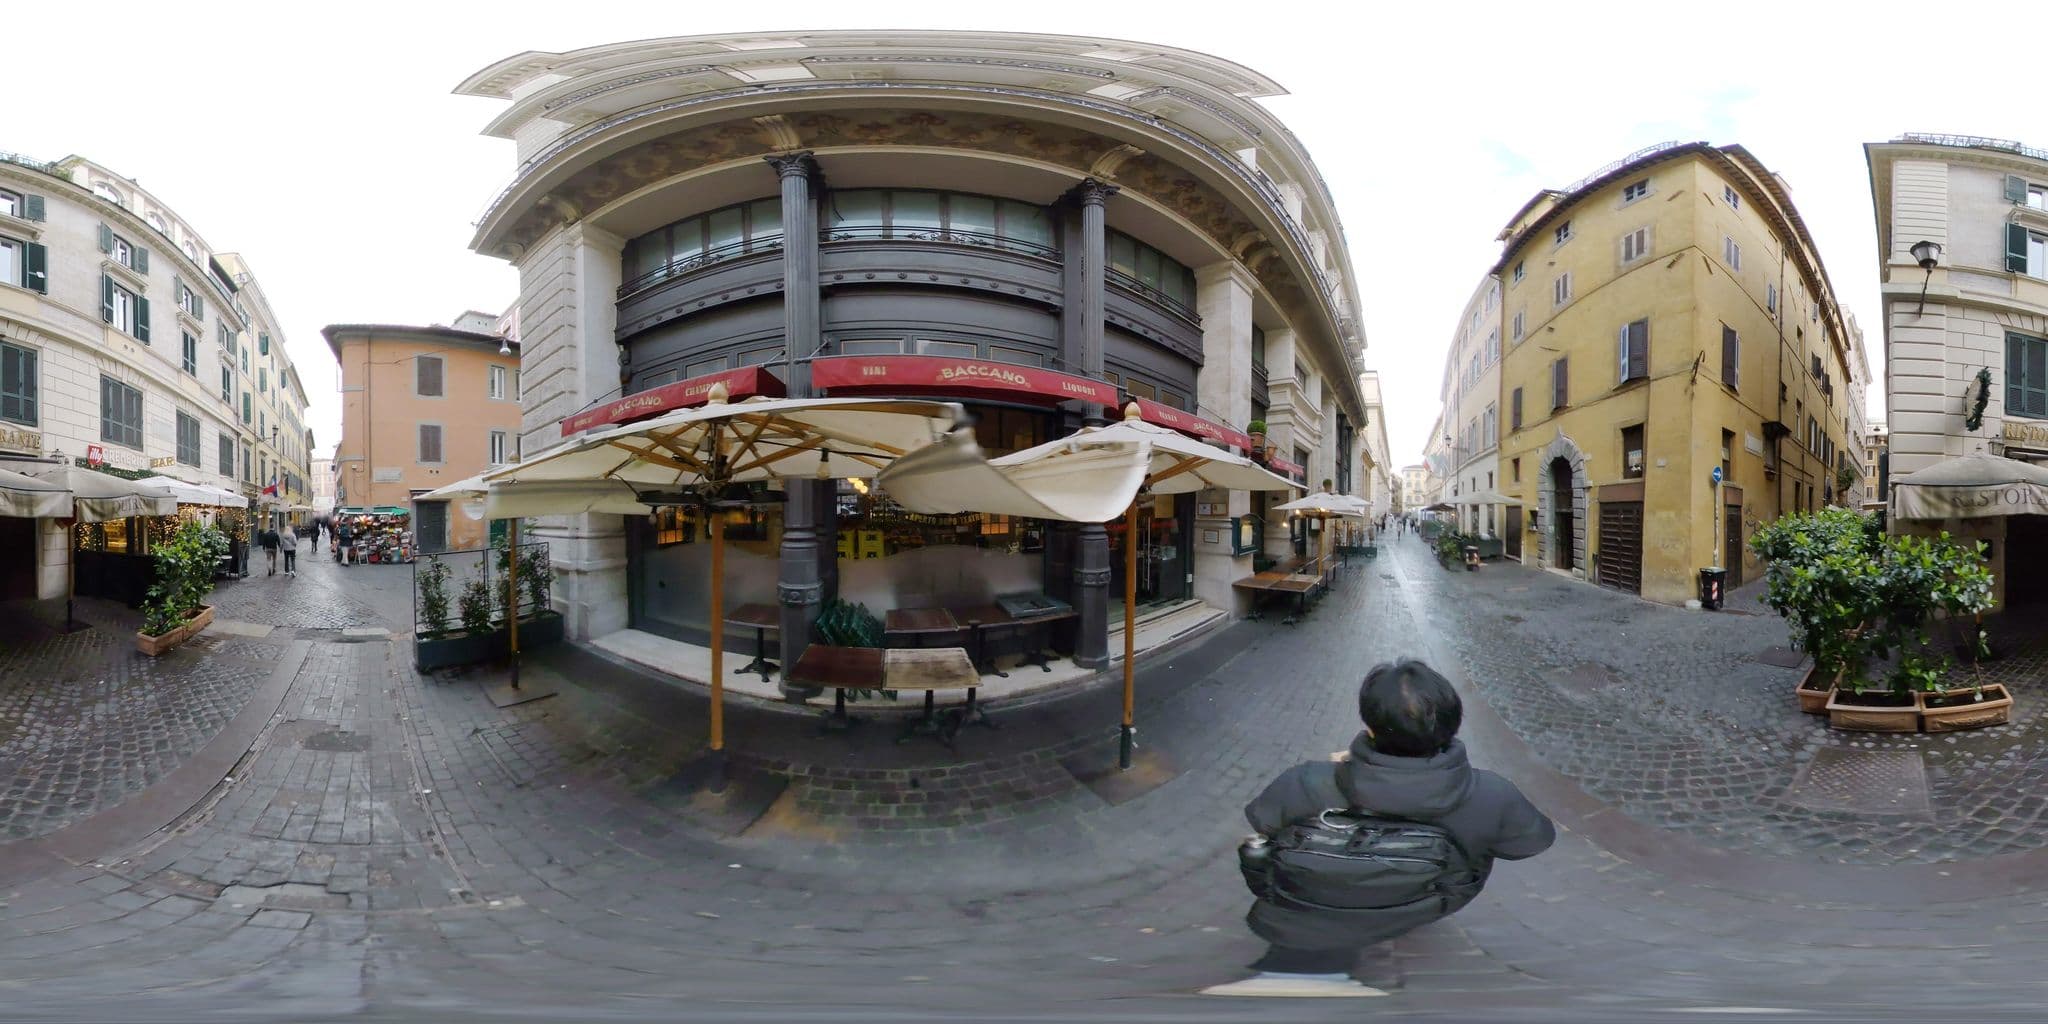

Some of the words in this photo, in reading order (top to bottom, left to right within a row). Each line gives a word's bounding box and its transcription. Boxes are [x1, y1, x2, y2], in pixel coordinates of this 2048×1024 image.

[942, 365, 1026, 385] BACCANO
[1062, 381, 1096, 396] LIQUORI
[90, 448, 103, 463] illy
[150, 456, 175, 469] BAR
